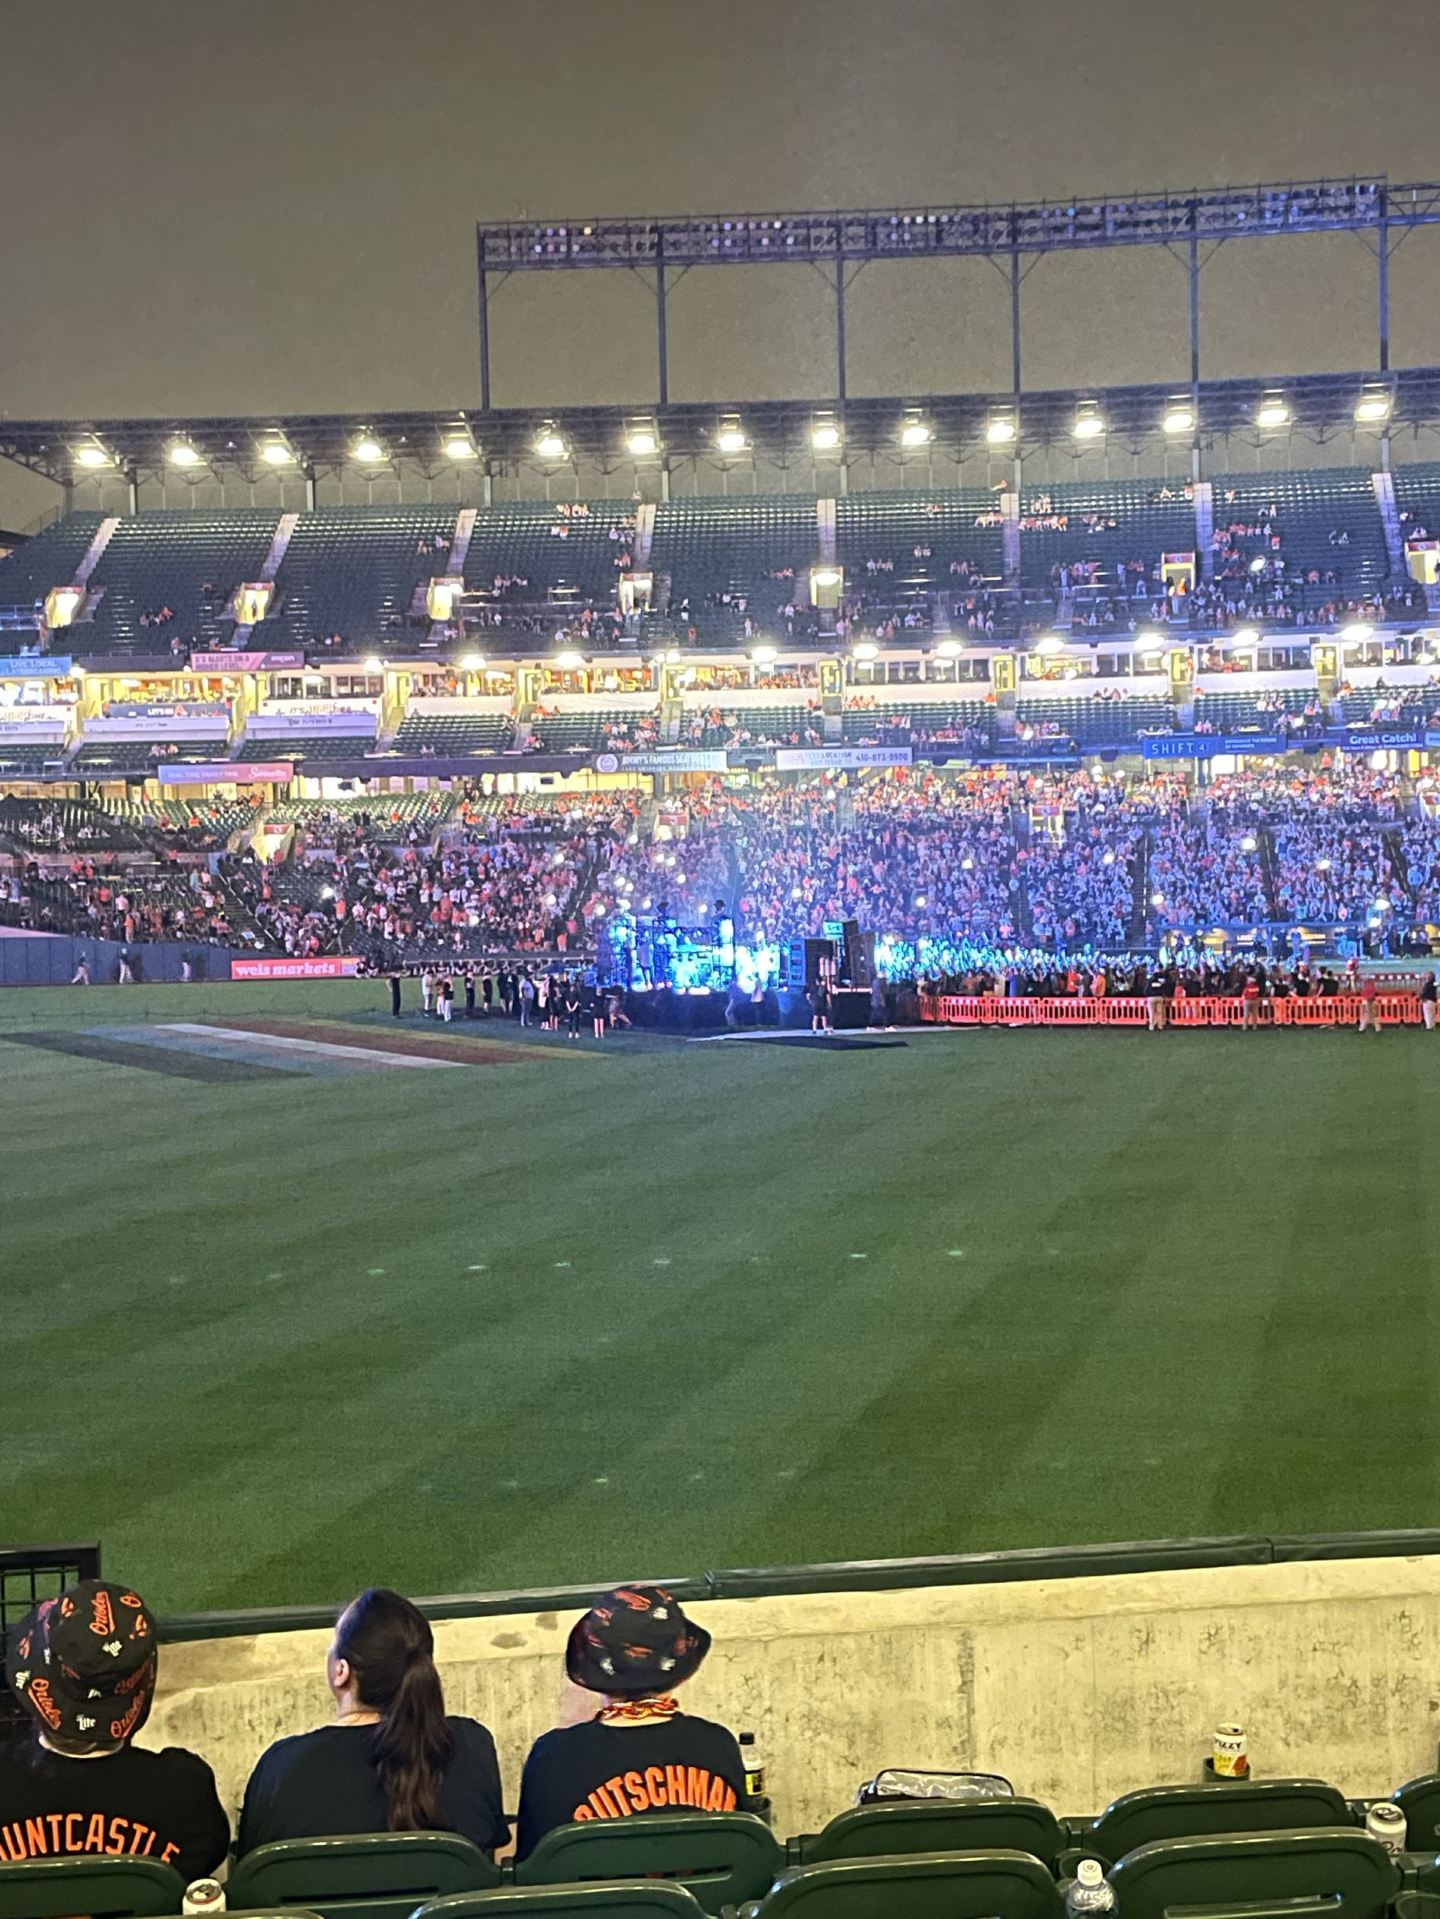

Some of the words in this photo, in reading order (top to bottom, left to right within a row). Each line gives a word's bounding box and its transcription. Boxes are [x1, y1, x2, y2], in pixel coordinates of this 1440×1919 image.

[1349, 735, 1379, 744] Great
[1382, 733, 1417, 743] Catch!
[1151, 742, 1194, 755] SHIFT
[236, 964, 270, 976] weis
[272, 962, 335, 975] markets
[0, 1813, 181, 1864] UNTCASTLE
